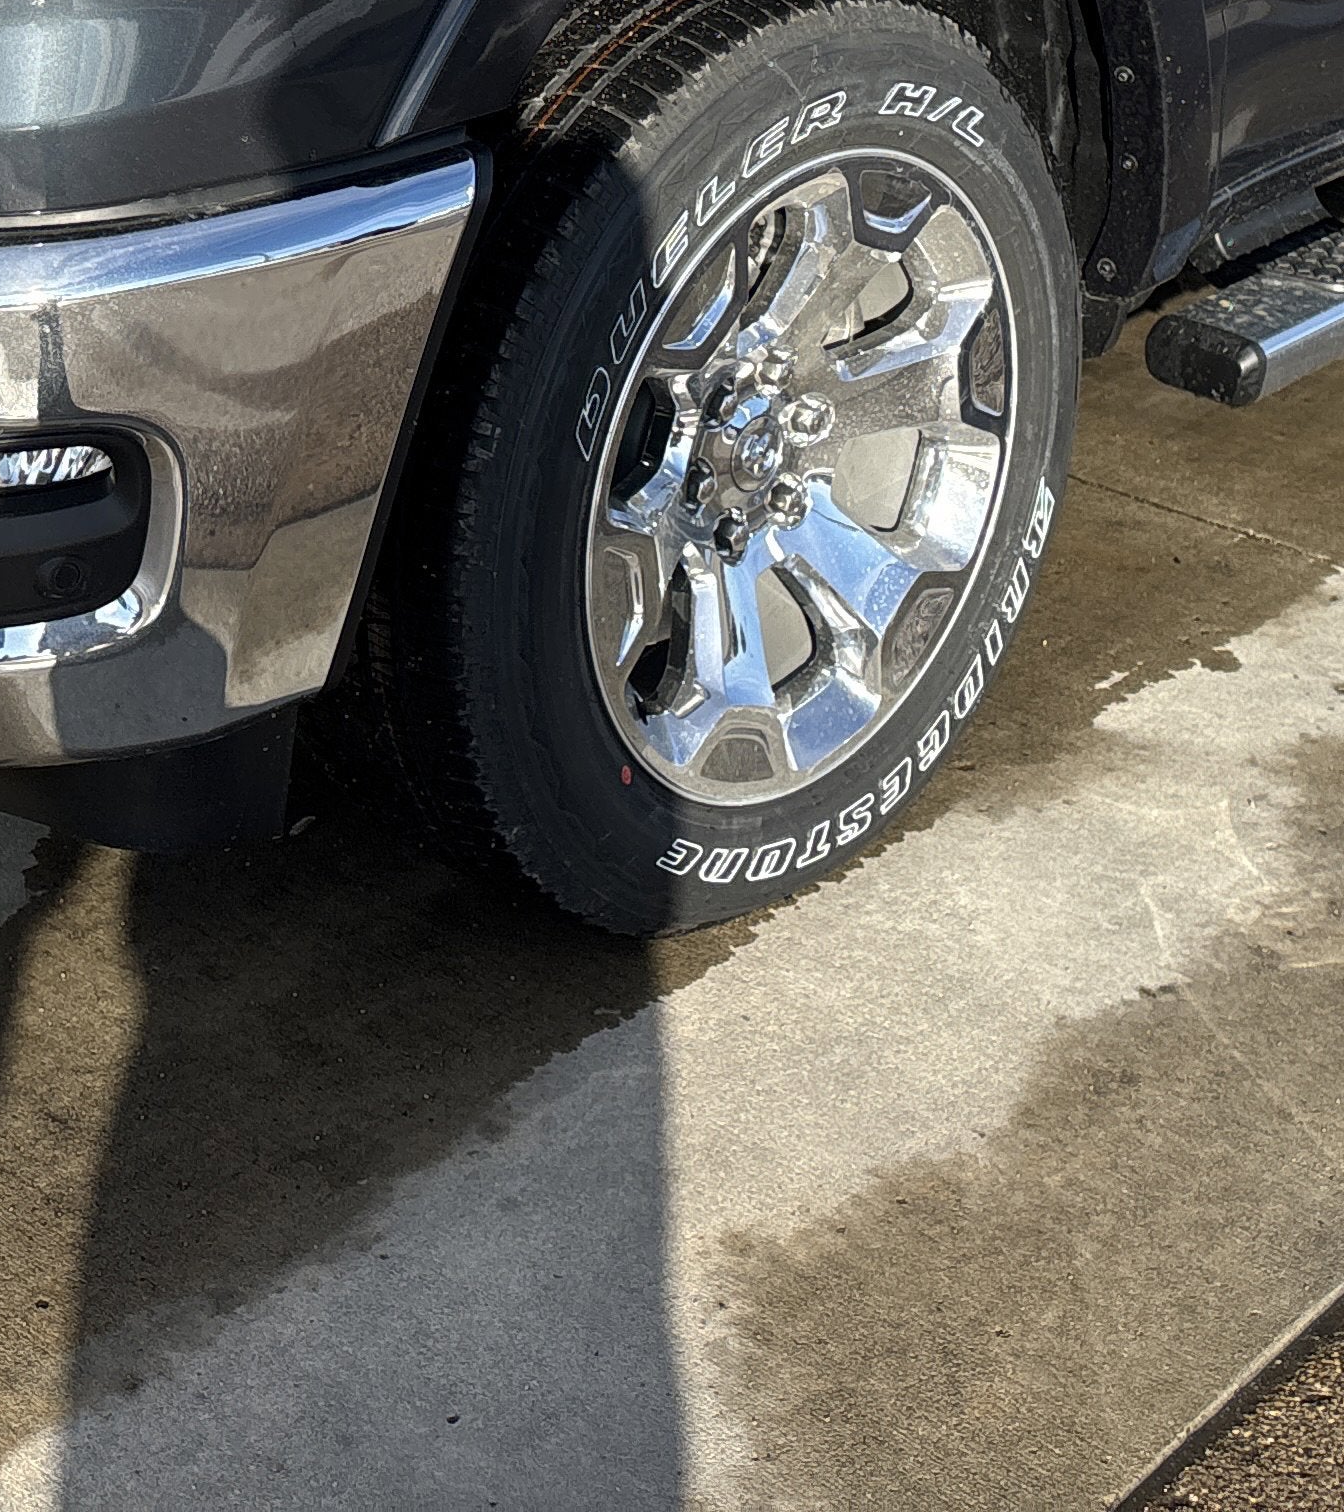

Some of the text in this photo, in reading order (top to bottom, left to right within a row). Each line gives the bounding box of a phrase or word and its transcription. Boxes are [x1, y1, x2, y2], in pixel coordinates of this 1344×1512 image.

[575, 81, 986, 462] DUELER H/L
[656, 476, 1056, 884] BRIDGESTONE
